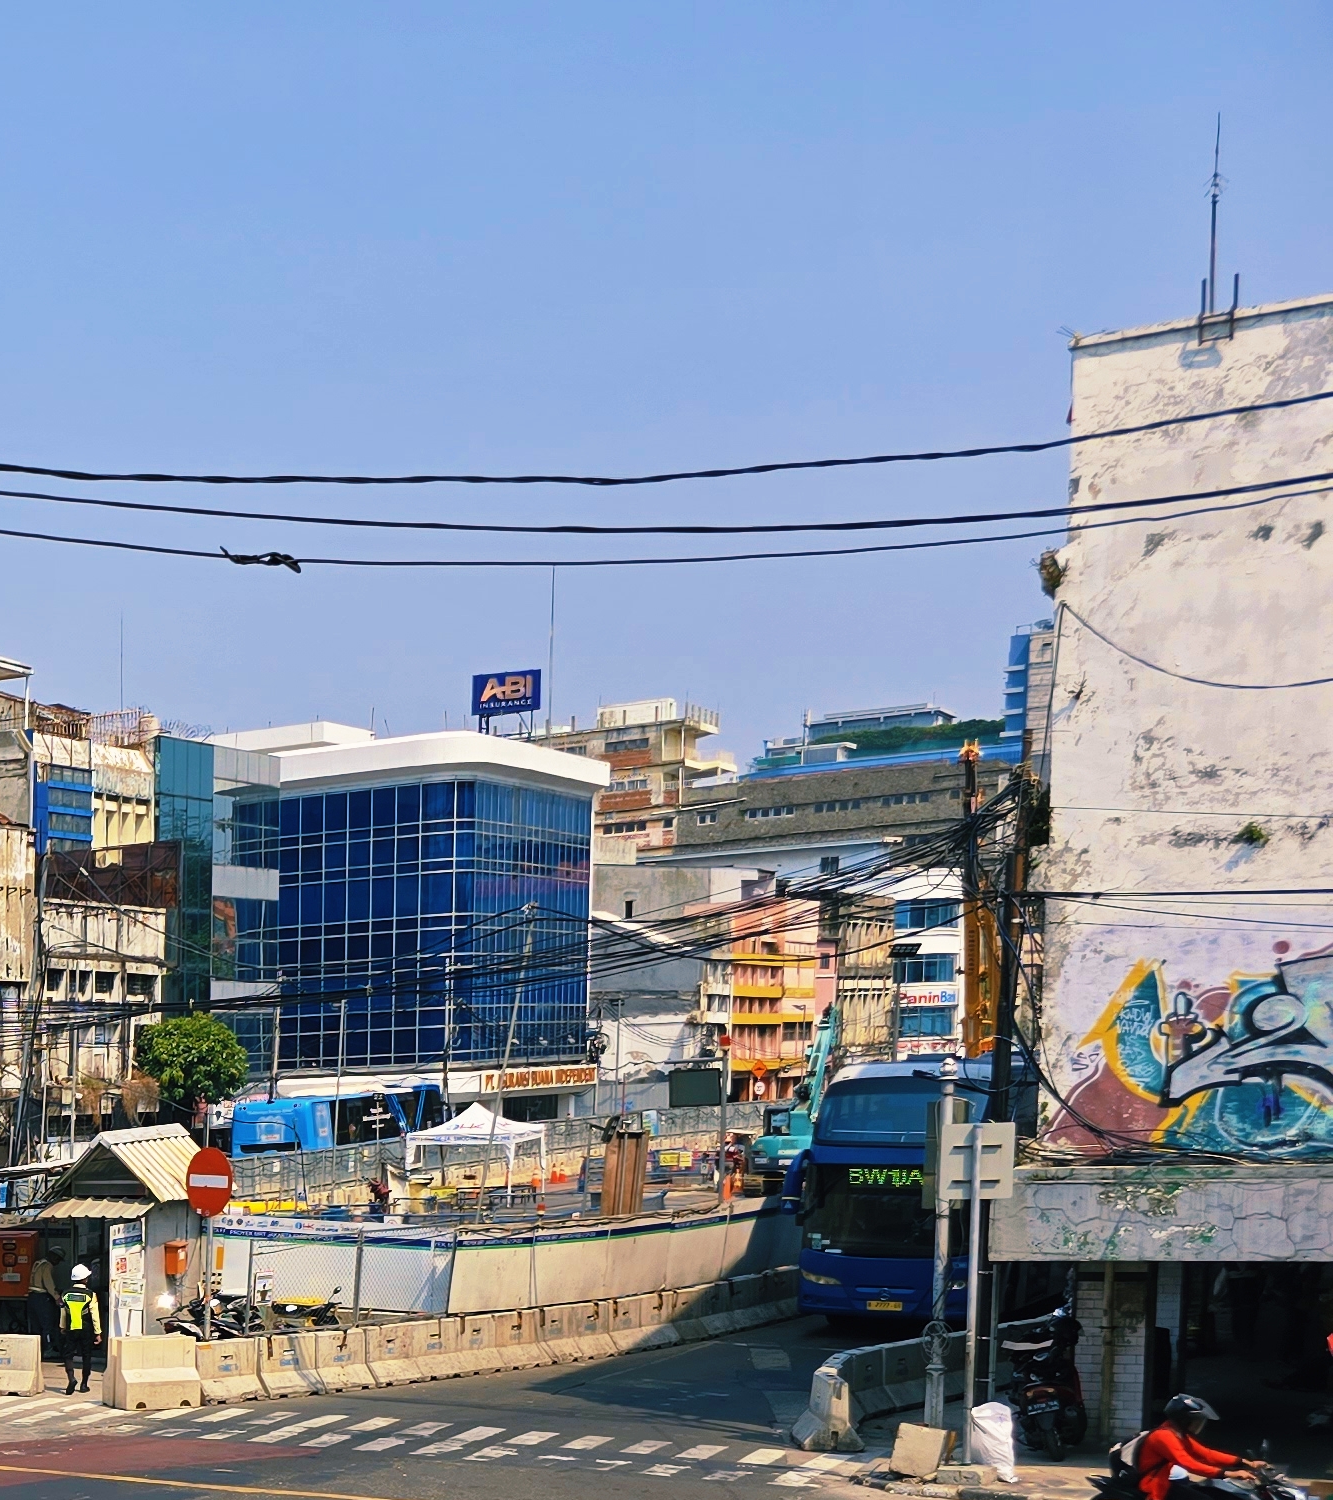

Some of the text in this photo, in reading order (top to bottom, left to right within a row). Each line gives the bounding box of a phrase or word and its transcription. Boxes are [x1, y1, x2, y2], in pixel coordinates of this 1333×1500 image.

[480, 675, 533, 702] ABI
[479, 699, 532, 709] INSURANCE
[531, 1069, 553, 1087] BUANA
[555, 1067, 596, 1085] INDEPENDENT
